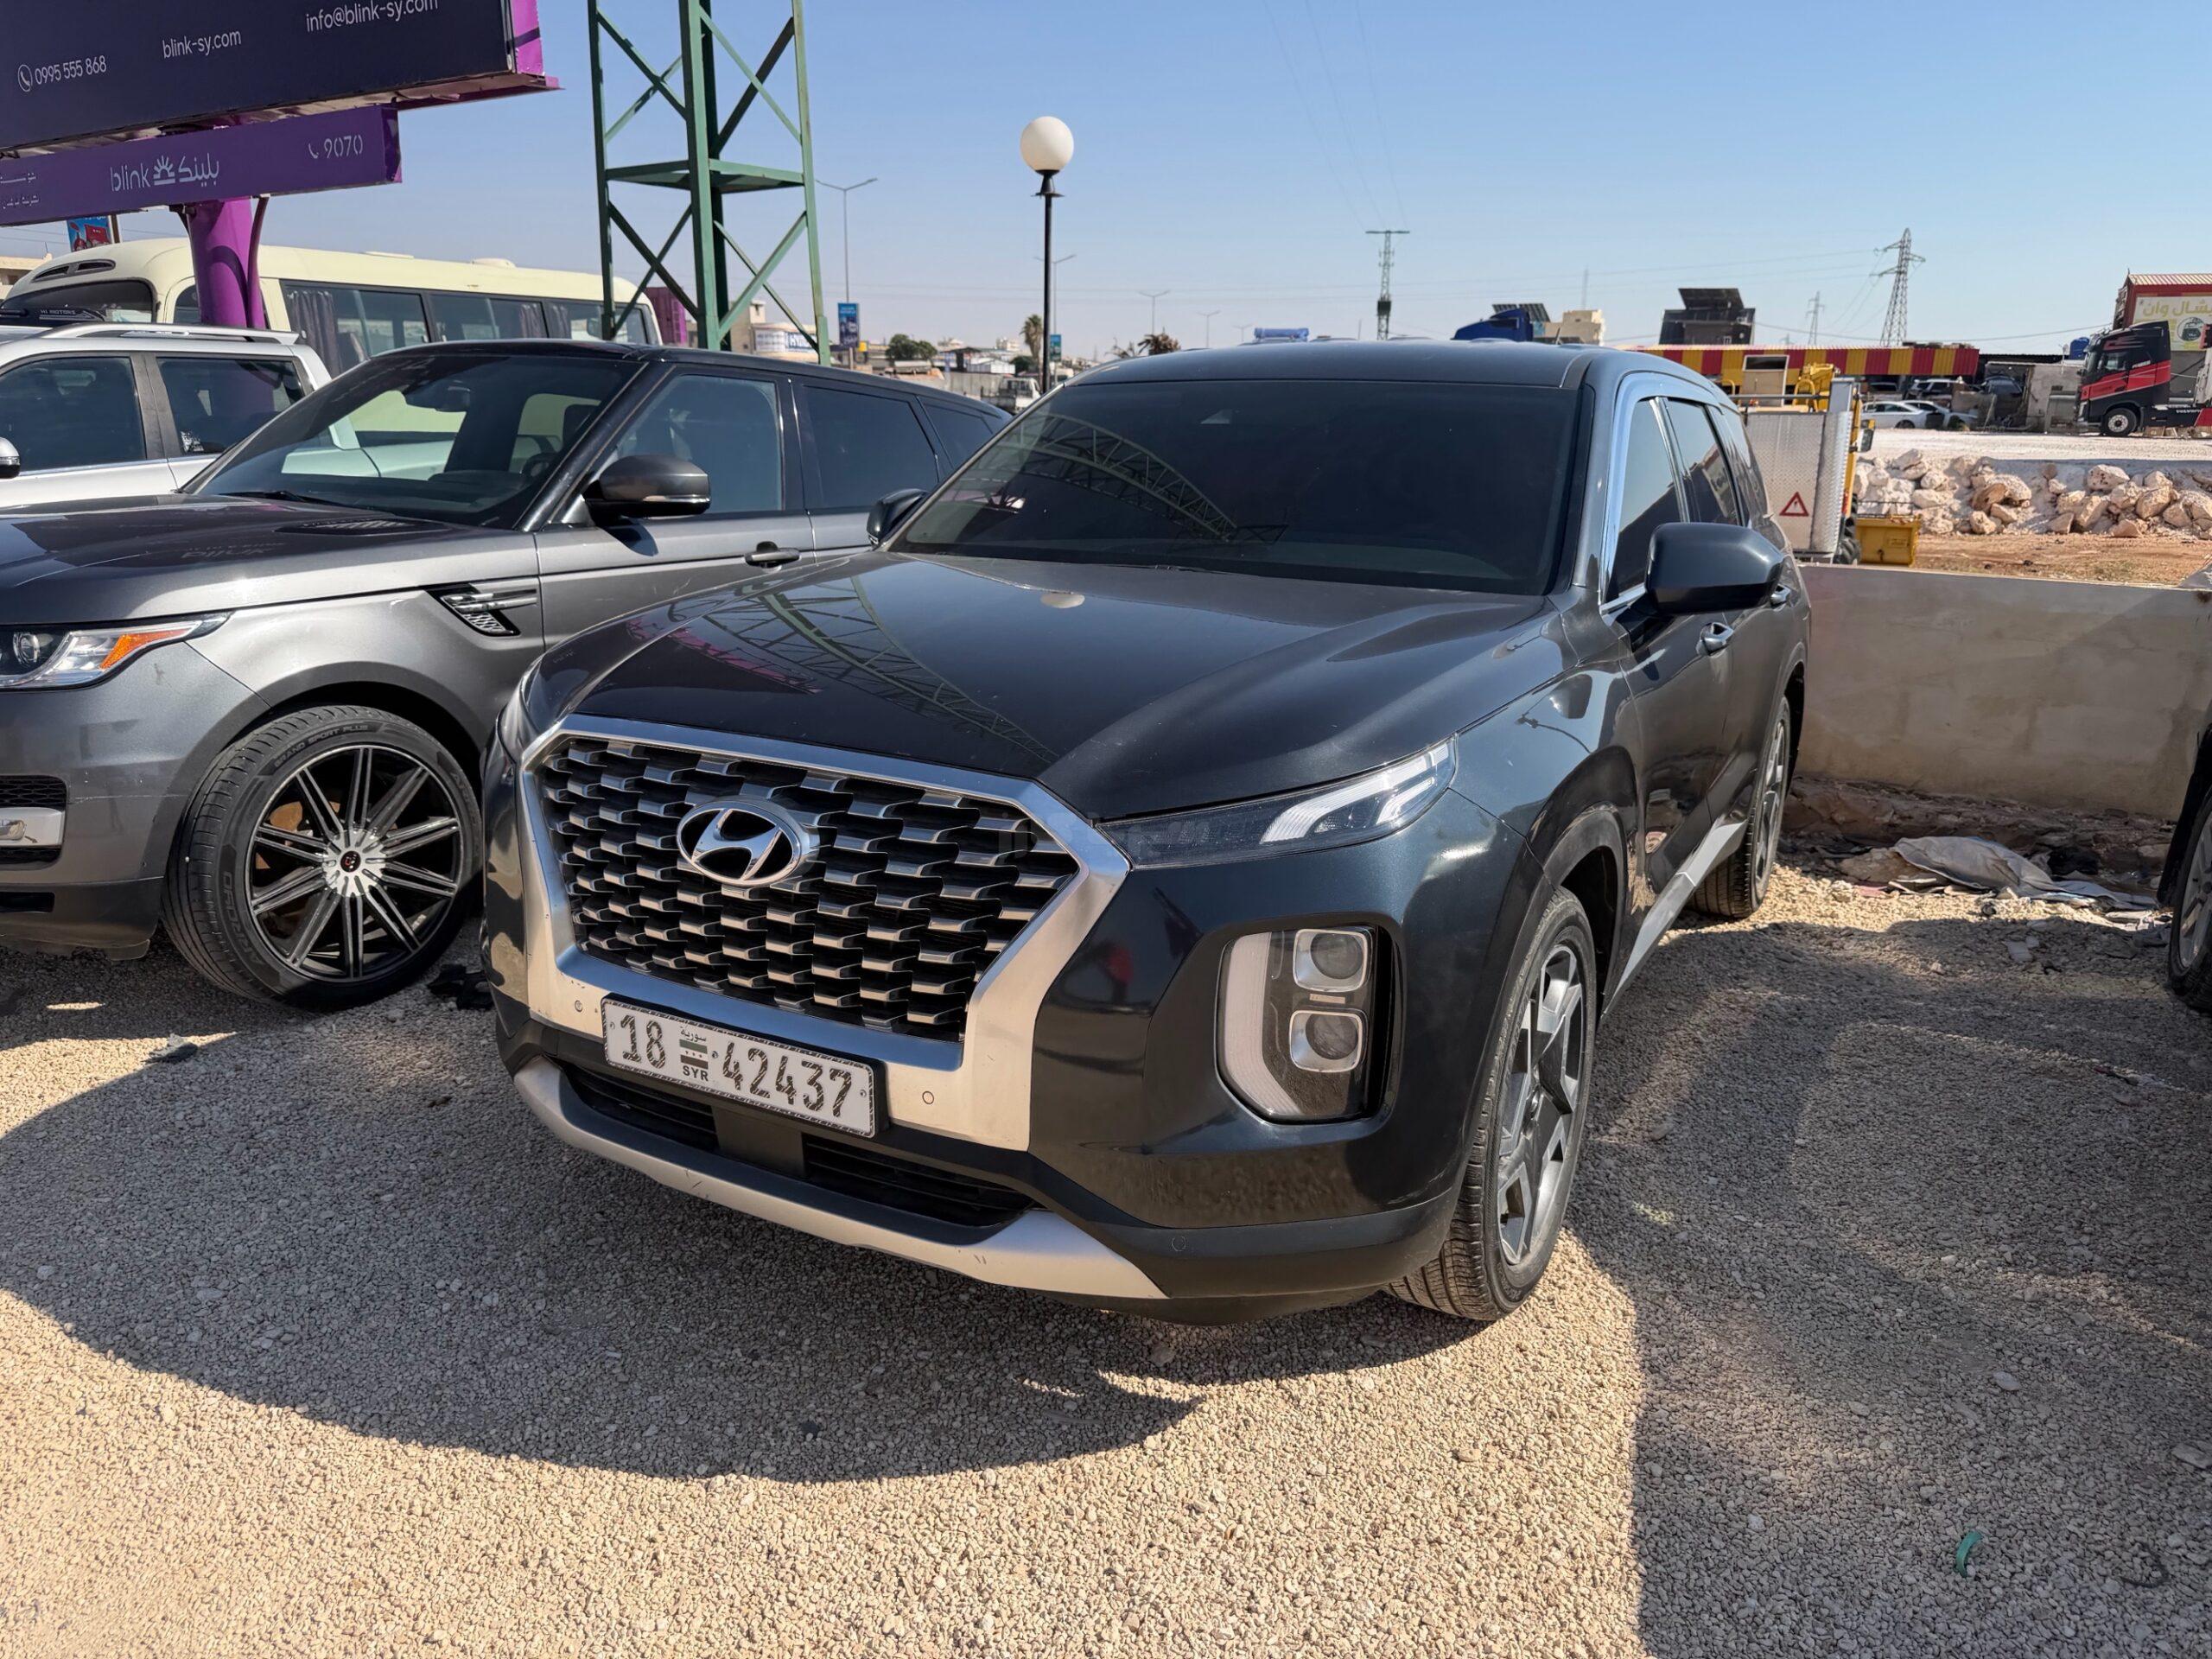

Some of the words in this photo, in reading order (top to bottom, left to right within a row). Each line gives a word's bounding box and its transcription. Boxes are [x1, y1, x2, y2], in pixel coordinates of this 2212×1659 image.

[306, 0, 438, 33] info@blink-sy.com
[162, 29, 242, 59] blink-sy.com
[35, 64, 61, 85] 0995
[62, 60, 84, 79] 555
[86, 54, 107, 76] 868
[323, 134, 364, 160] 9070
[110, 162, 151, 192] blink
[177, 152, 220, 188] بلينك
[274, 741, 307, 768] GRAND
[308, 728, 341, 745] SPORT
[680, 1026, 707, 1043] سورية
[620, 1014, 666, 1070] 18
[722, 1041, 853, 1118] 42437
[682, 1065, 709, 1082] SYR
